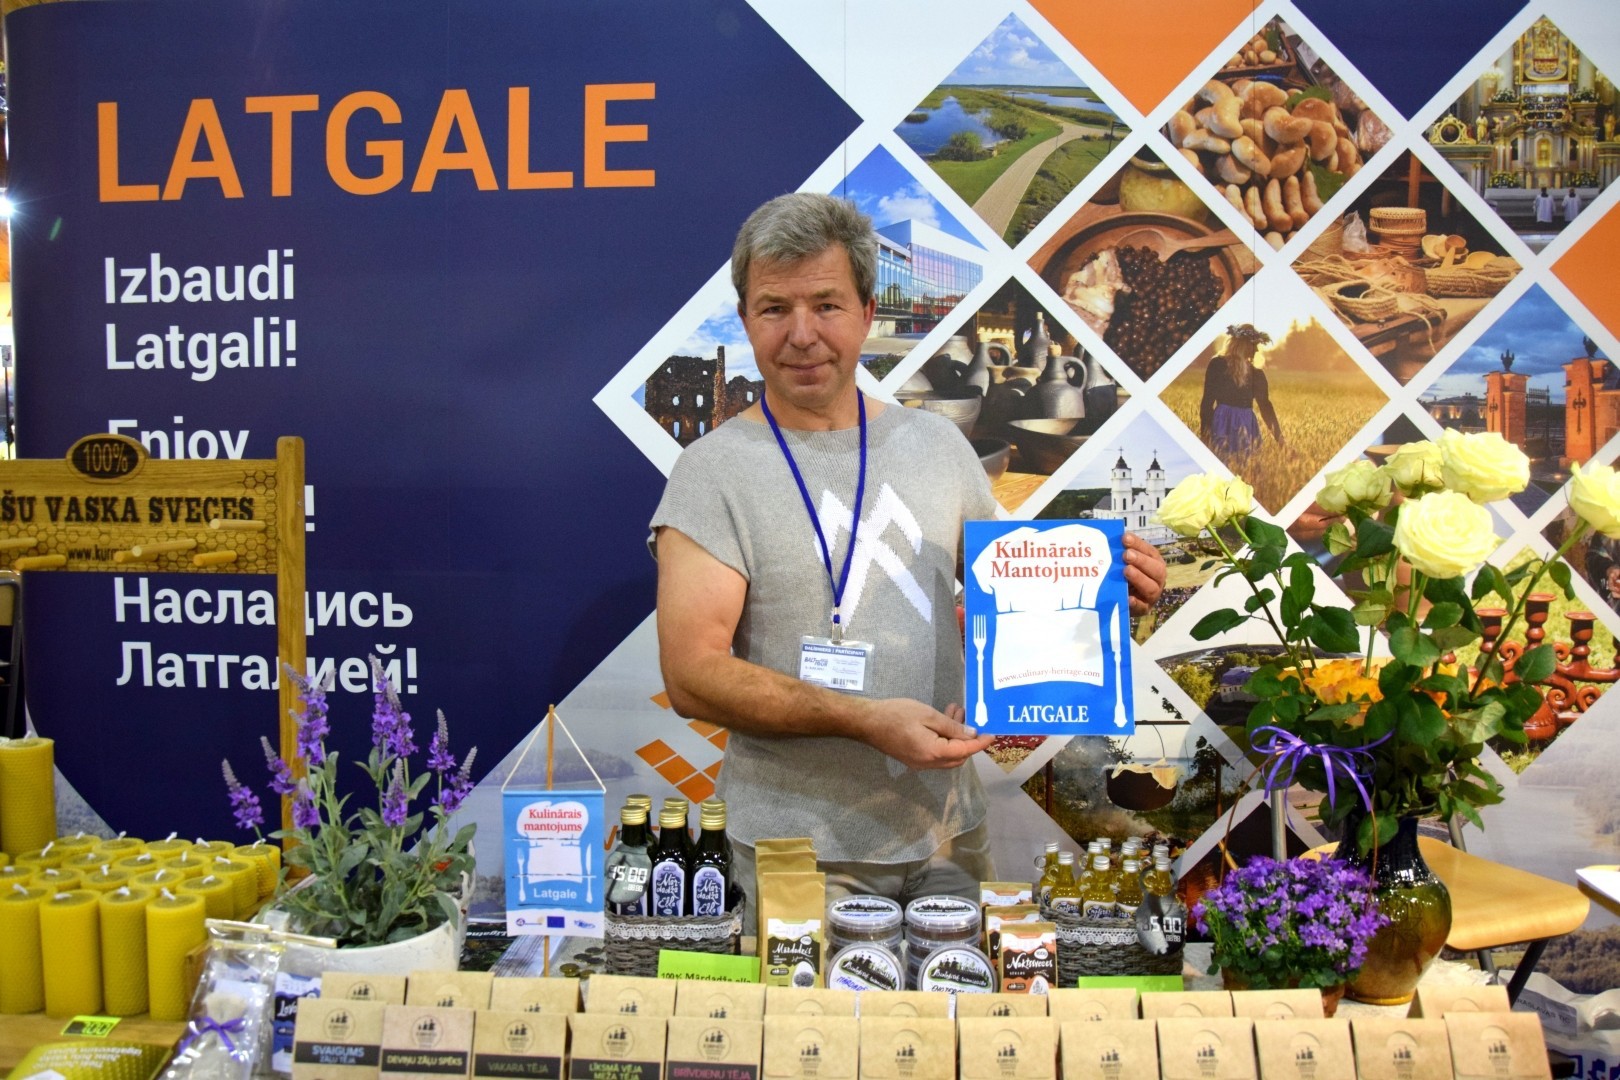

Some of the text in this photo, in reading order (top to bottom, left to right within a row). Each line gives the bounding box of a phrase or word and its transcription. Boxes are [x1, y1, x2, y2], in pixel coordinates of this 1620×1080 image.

[98, 83, 656, 202] LATGALE
[104, 249, 295, 303] Izbaudi
[106, 319, 297, 381] Latgali!
[83, 443, 128, 472] 100%
[45, 496, 141, 523] VASKA
[149, 496, 254, 523] SVECES
[995, 541, 1092, 558] Kulinārais
[990, 560, 1099, 583] Mantojums
[116, 641, 418, 695] Латгаией!
[998, 667, 1100, 684] www.culinary-heritage.com
[1008, 705, 1089, 723] LATGALE
[529, 808, 582, 820] Kulinārais
[524, 823, 582, 834] mantojums
[533, 887, 577, 900] Latgale
[312, 1045, 364, 1057] SVAIGUMS
[488, 1062, 524, 1072] VAKARA
